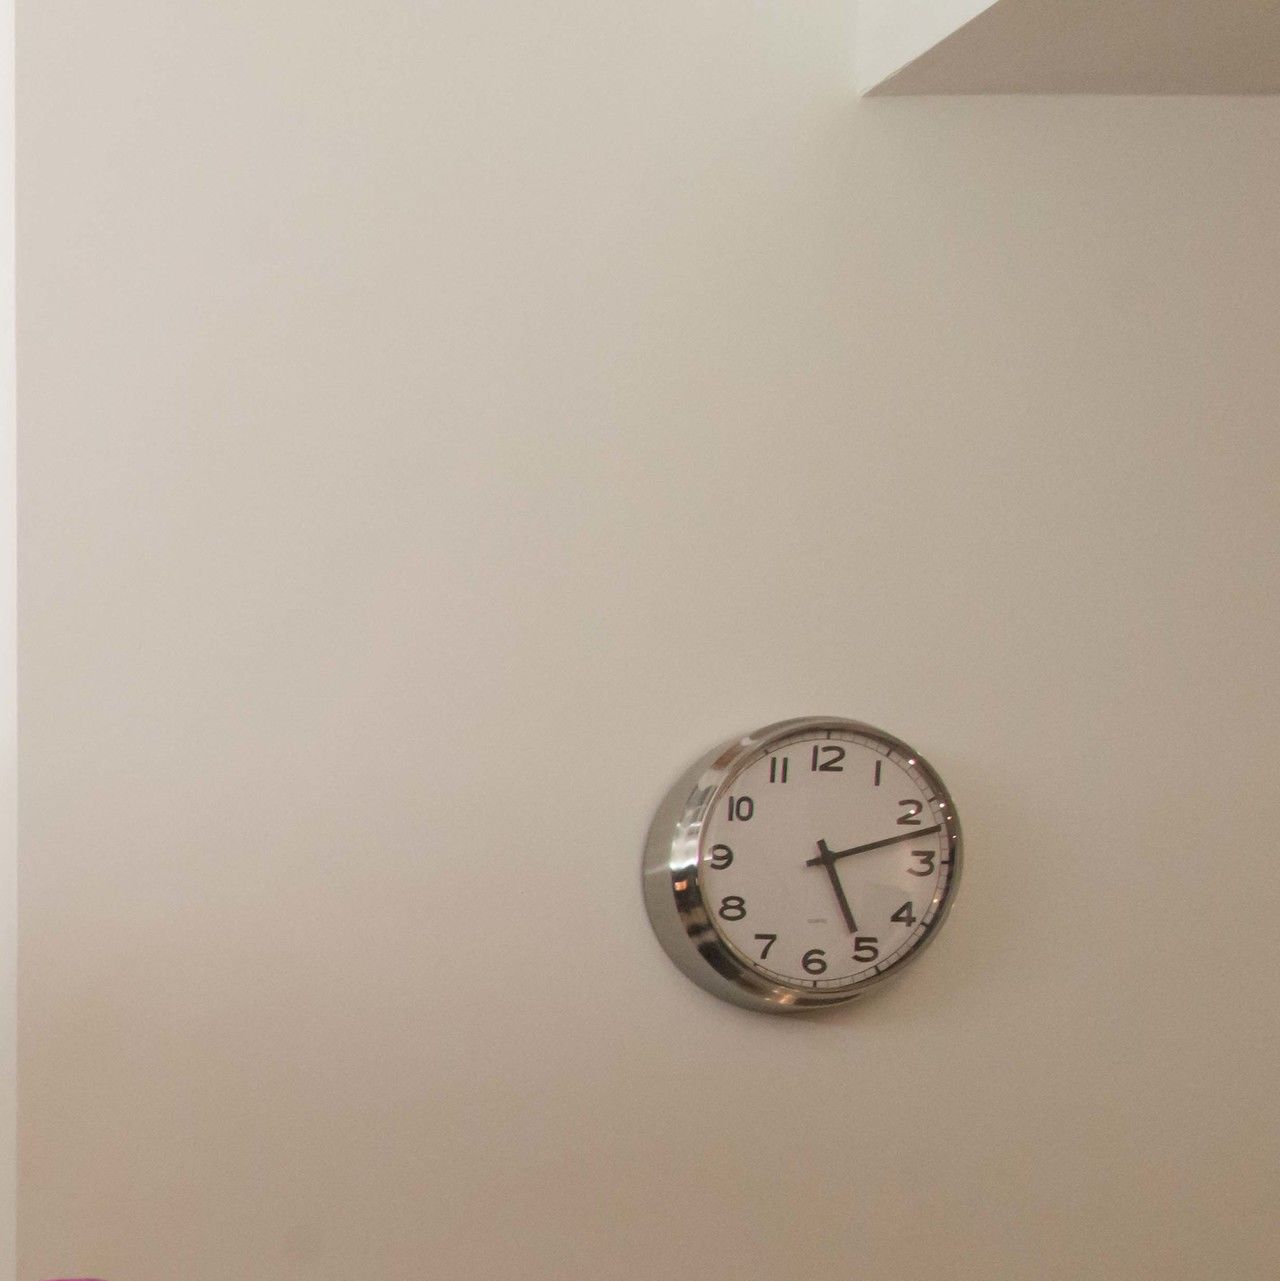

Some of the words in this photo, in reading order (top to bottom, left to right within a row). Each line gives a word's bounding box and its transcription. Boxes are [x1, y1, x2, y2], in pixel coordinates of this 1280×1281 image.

[769, 757, 788, 784] 11
[811, 745, 846, 772] 12
[874, 760, 882, 787] 1
[727, 796, 755, 822] 10
[896, 799, 923, 826] 2
[710, 844, 734, 871] 9
[907, 850, 936, 877] 3
[718, 895, 748, 922] 8
[890, 901, 917, 928] 4
[754, 933, 777, 960] 7
[852, 936, 879, 963] 5
[801, 949, 828, 975] 6
